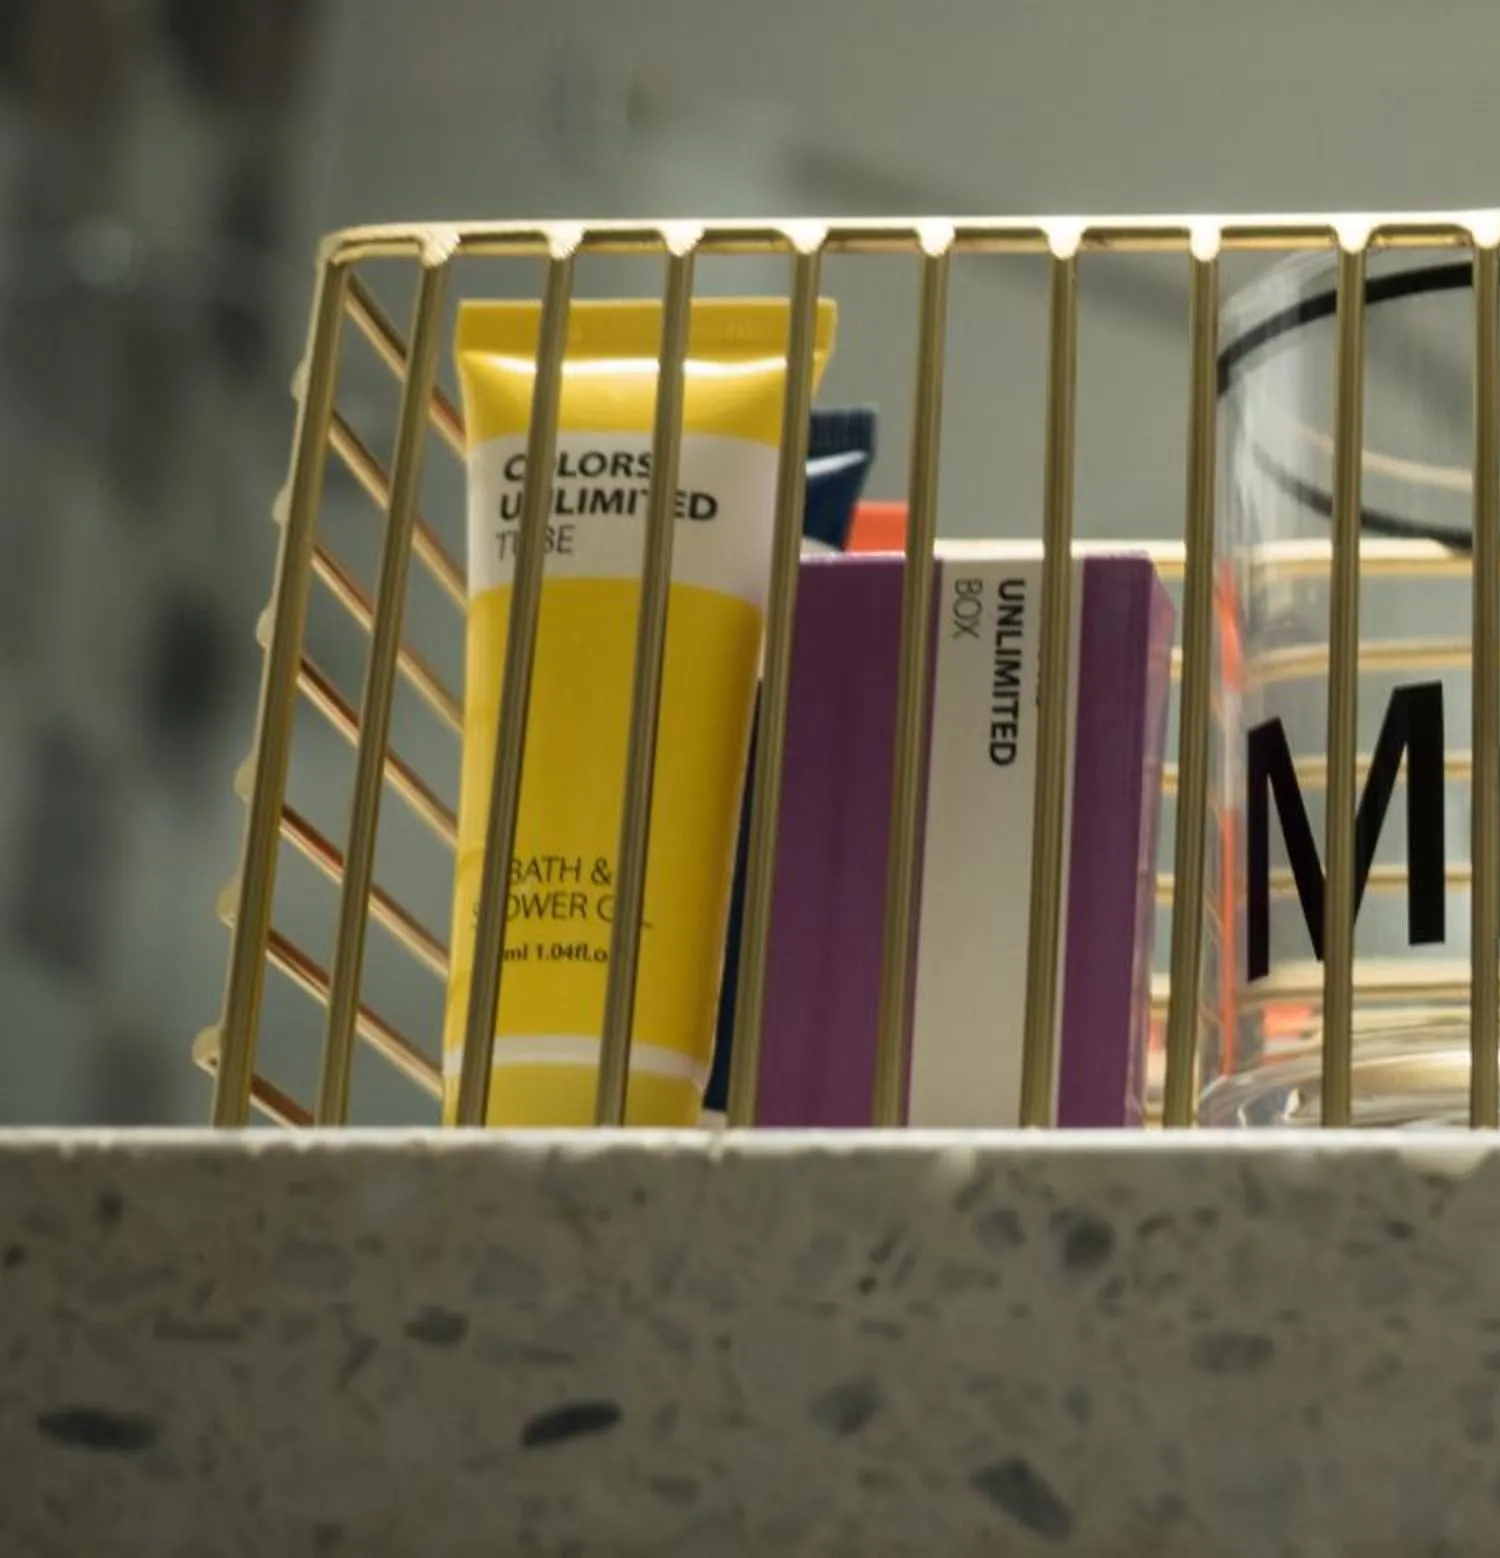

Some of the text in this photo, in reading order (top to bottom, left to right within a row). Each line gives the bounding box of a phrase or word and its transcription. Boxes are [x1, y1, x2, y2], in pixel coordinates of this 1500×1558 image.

[504, 452, 652, 481] CLORS
[500, 487, 719, 521] ULIMIED
[497, 525, 574, 560] TBE
[952, 579, 983, 640] BOX
[989, 579, 1025, 766] UNLIMITED
[590, 857, 613, 885] &
[536, 944, 610, 962] 1.04fl.o
